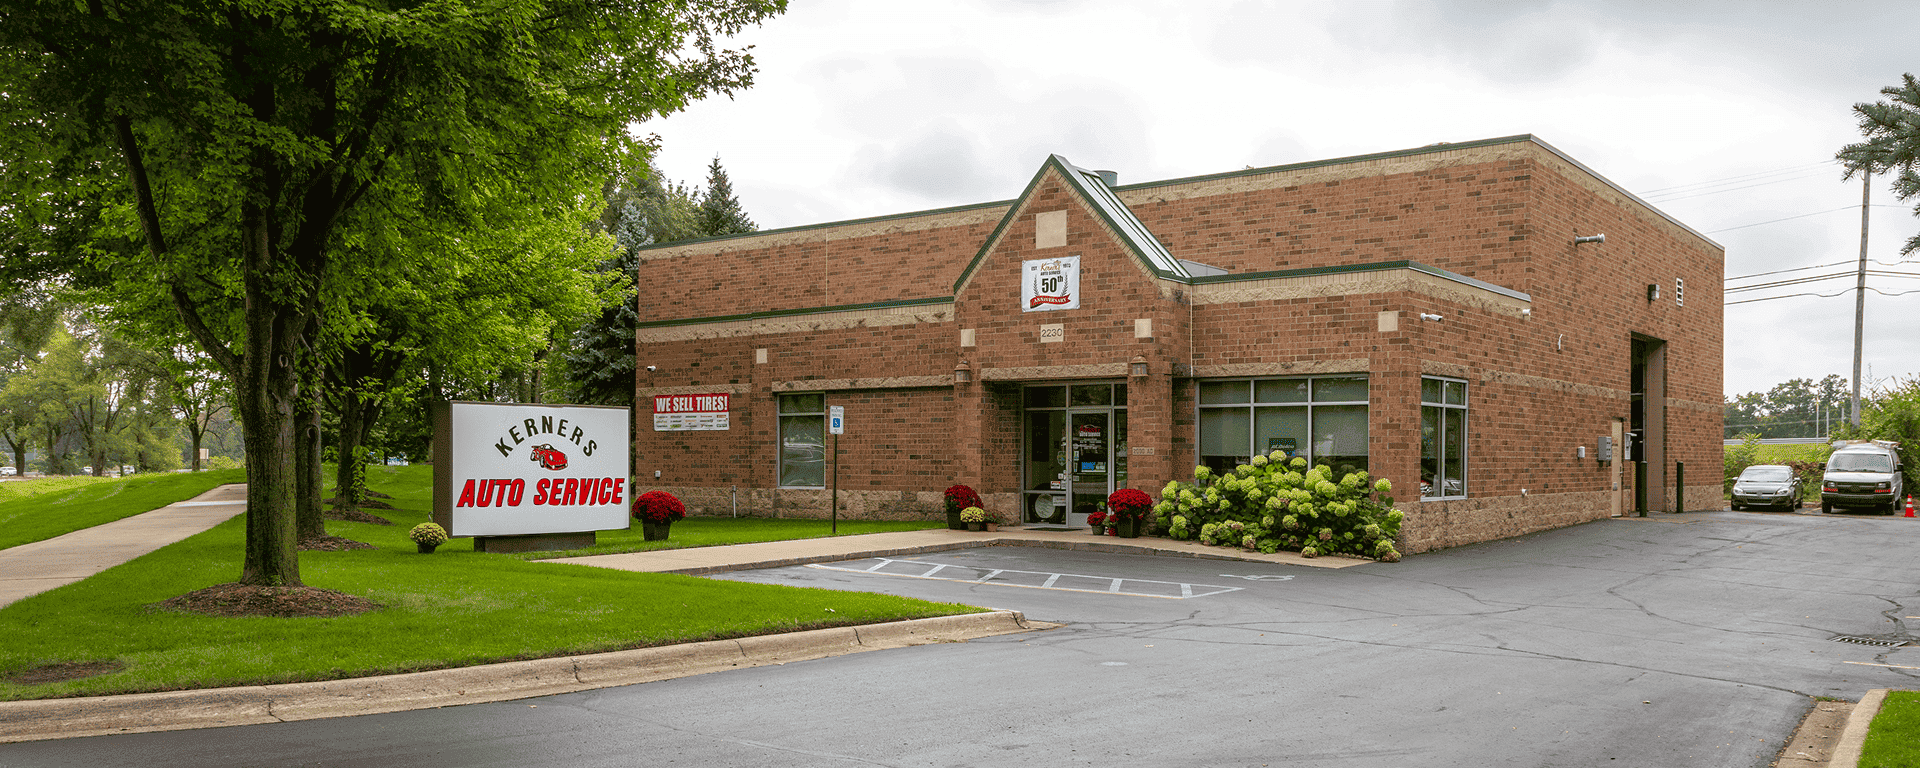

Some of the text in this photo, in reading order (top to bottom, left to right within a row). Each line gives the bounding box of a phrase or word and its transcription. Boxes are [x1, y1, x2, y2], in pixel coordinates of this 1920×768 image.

[1042, 276, 1064, 293] 50th
[1034, 296, 1067, 304] ANNIVERSARY
[1042, 328, 1062, 337] 2230
[656, 396, 728, 412] WE SELL TIRES!
[494, 416, 597, 458] KERNERS
[456, 477, 625, 508] AUTO SERVICE
